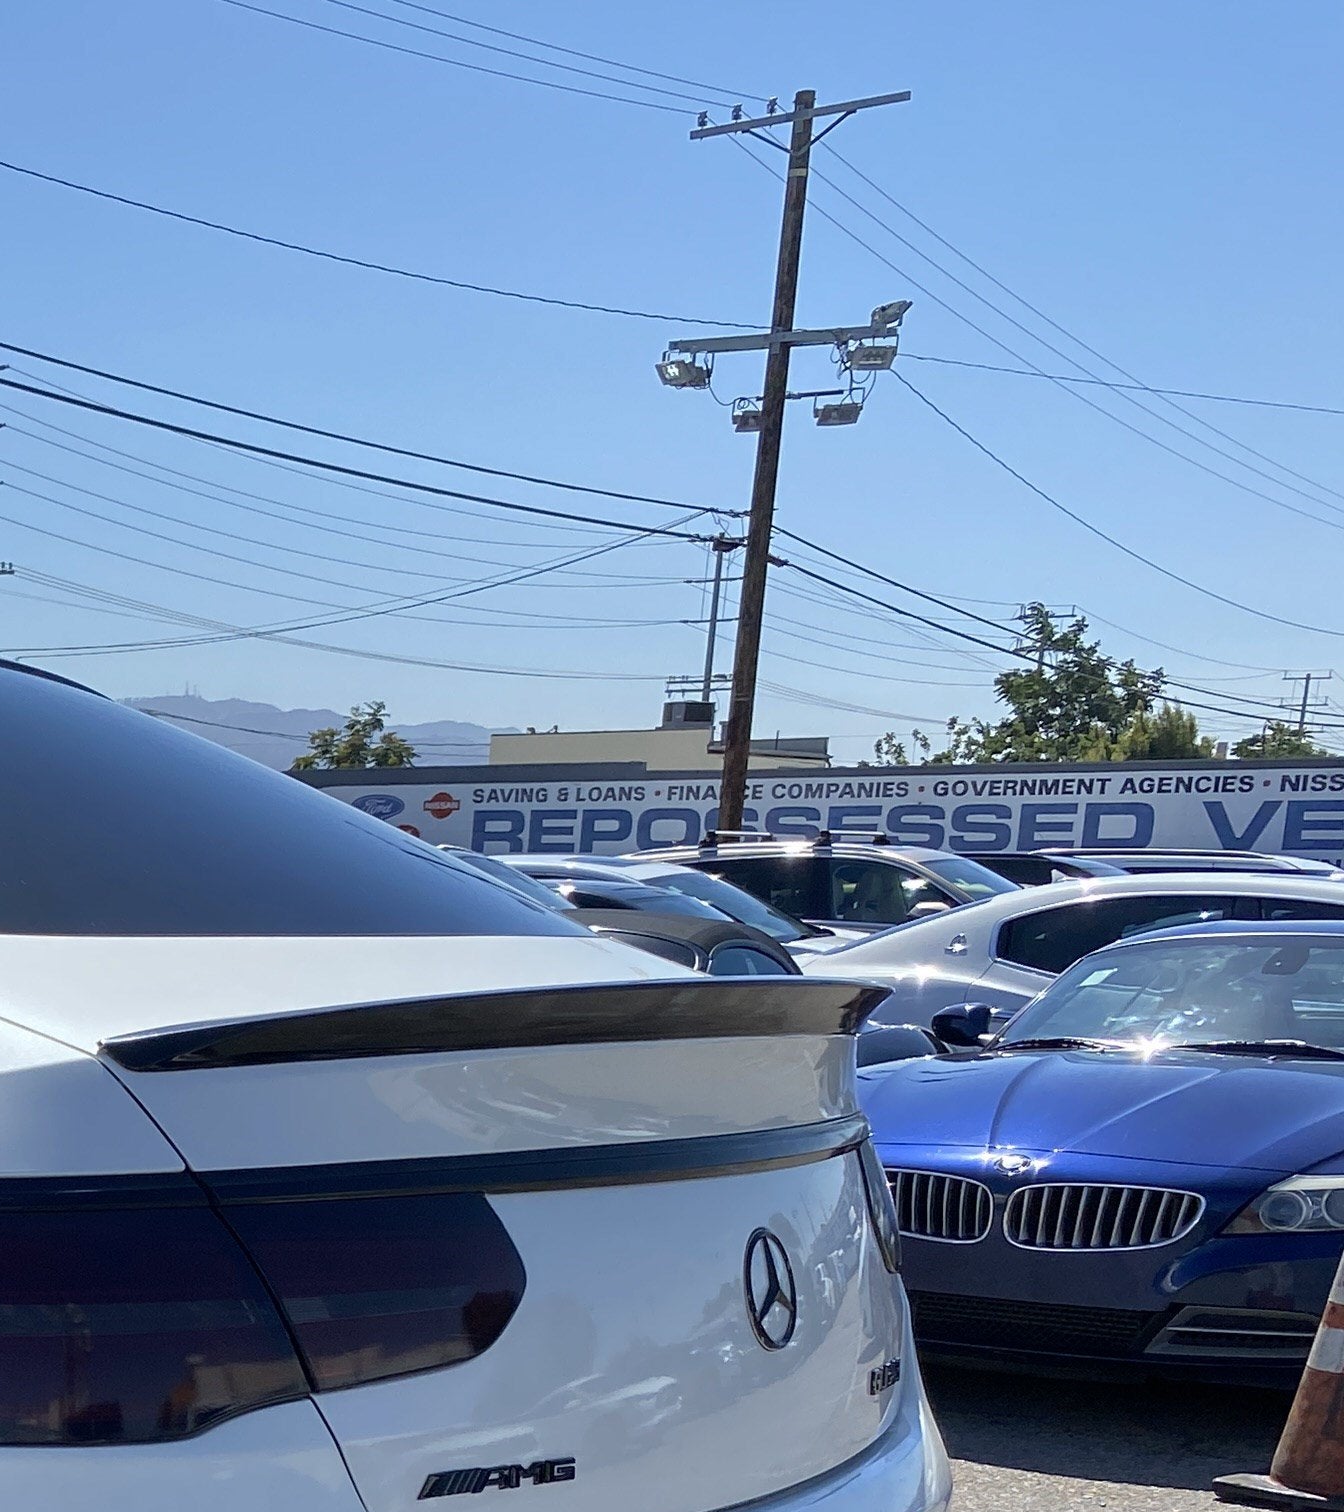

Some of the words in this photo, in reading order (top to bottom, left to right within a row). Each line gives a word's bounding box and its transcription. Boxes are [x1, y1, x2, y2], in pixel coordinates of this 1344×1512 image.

[472, 787, 549, 804] SAVING
[557, 787, 570, 803] &
[576, 785, 646, 802] LOANS
[667, 783, 764, 802] FINAE
[771, 781, 910, 801] COMPANIES
[933, 777, 1111, 798] GOVERNMENT
[1119, 775, 1254, 795] AGENCIES
[1280, 773, 1344, 793] NISS
